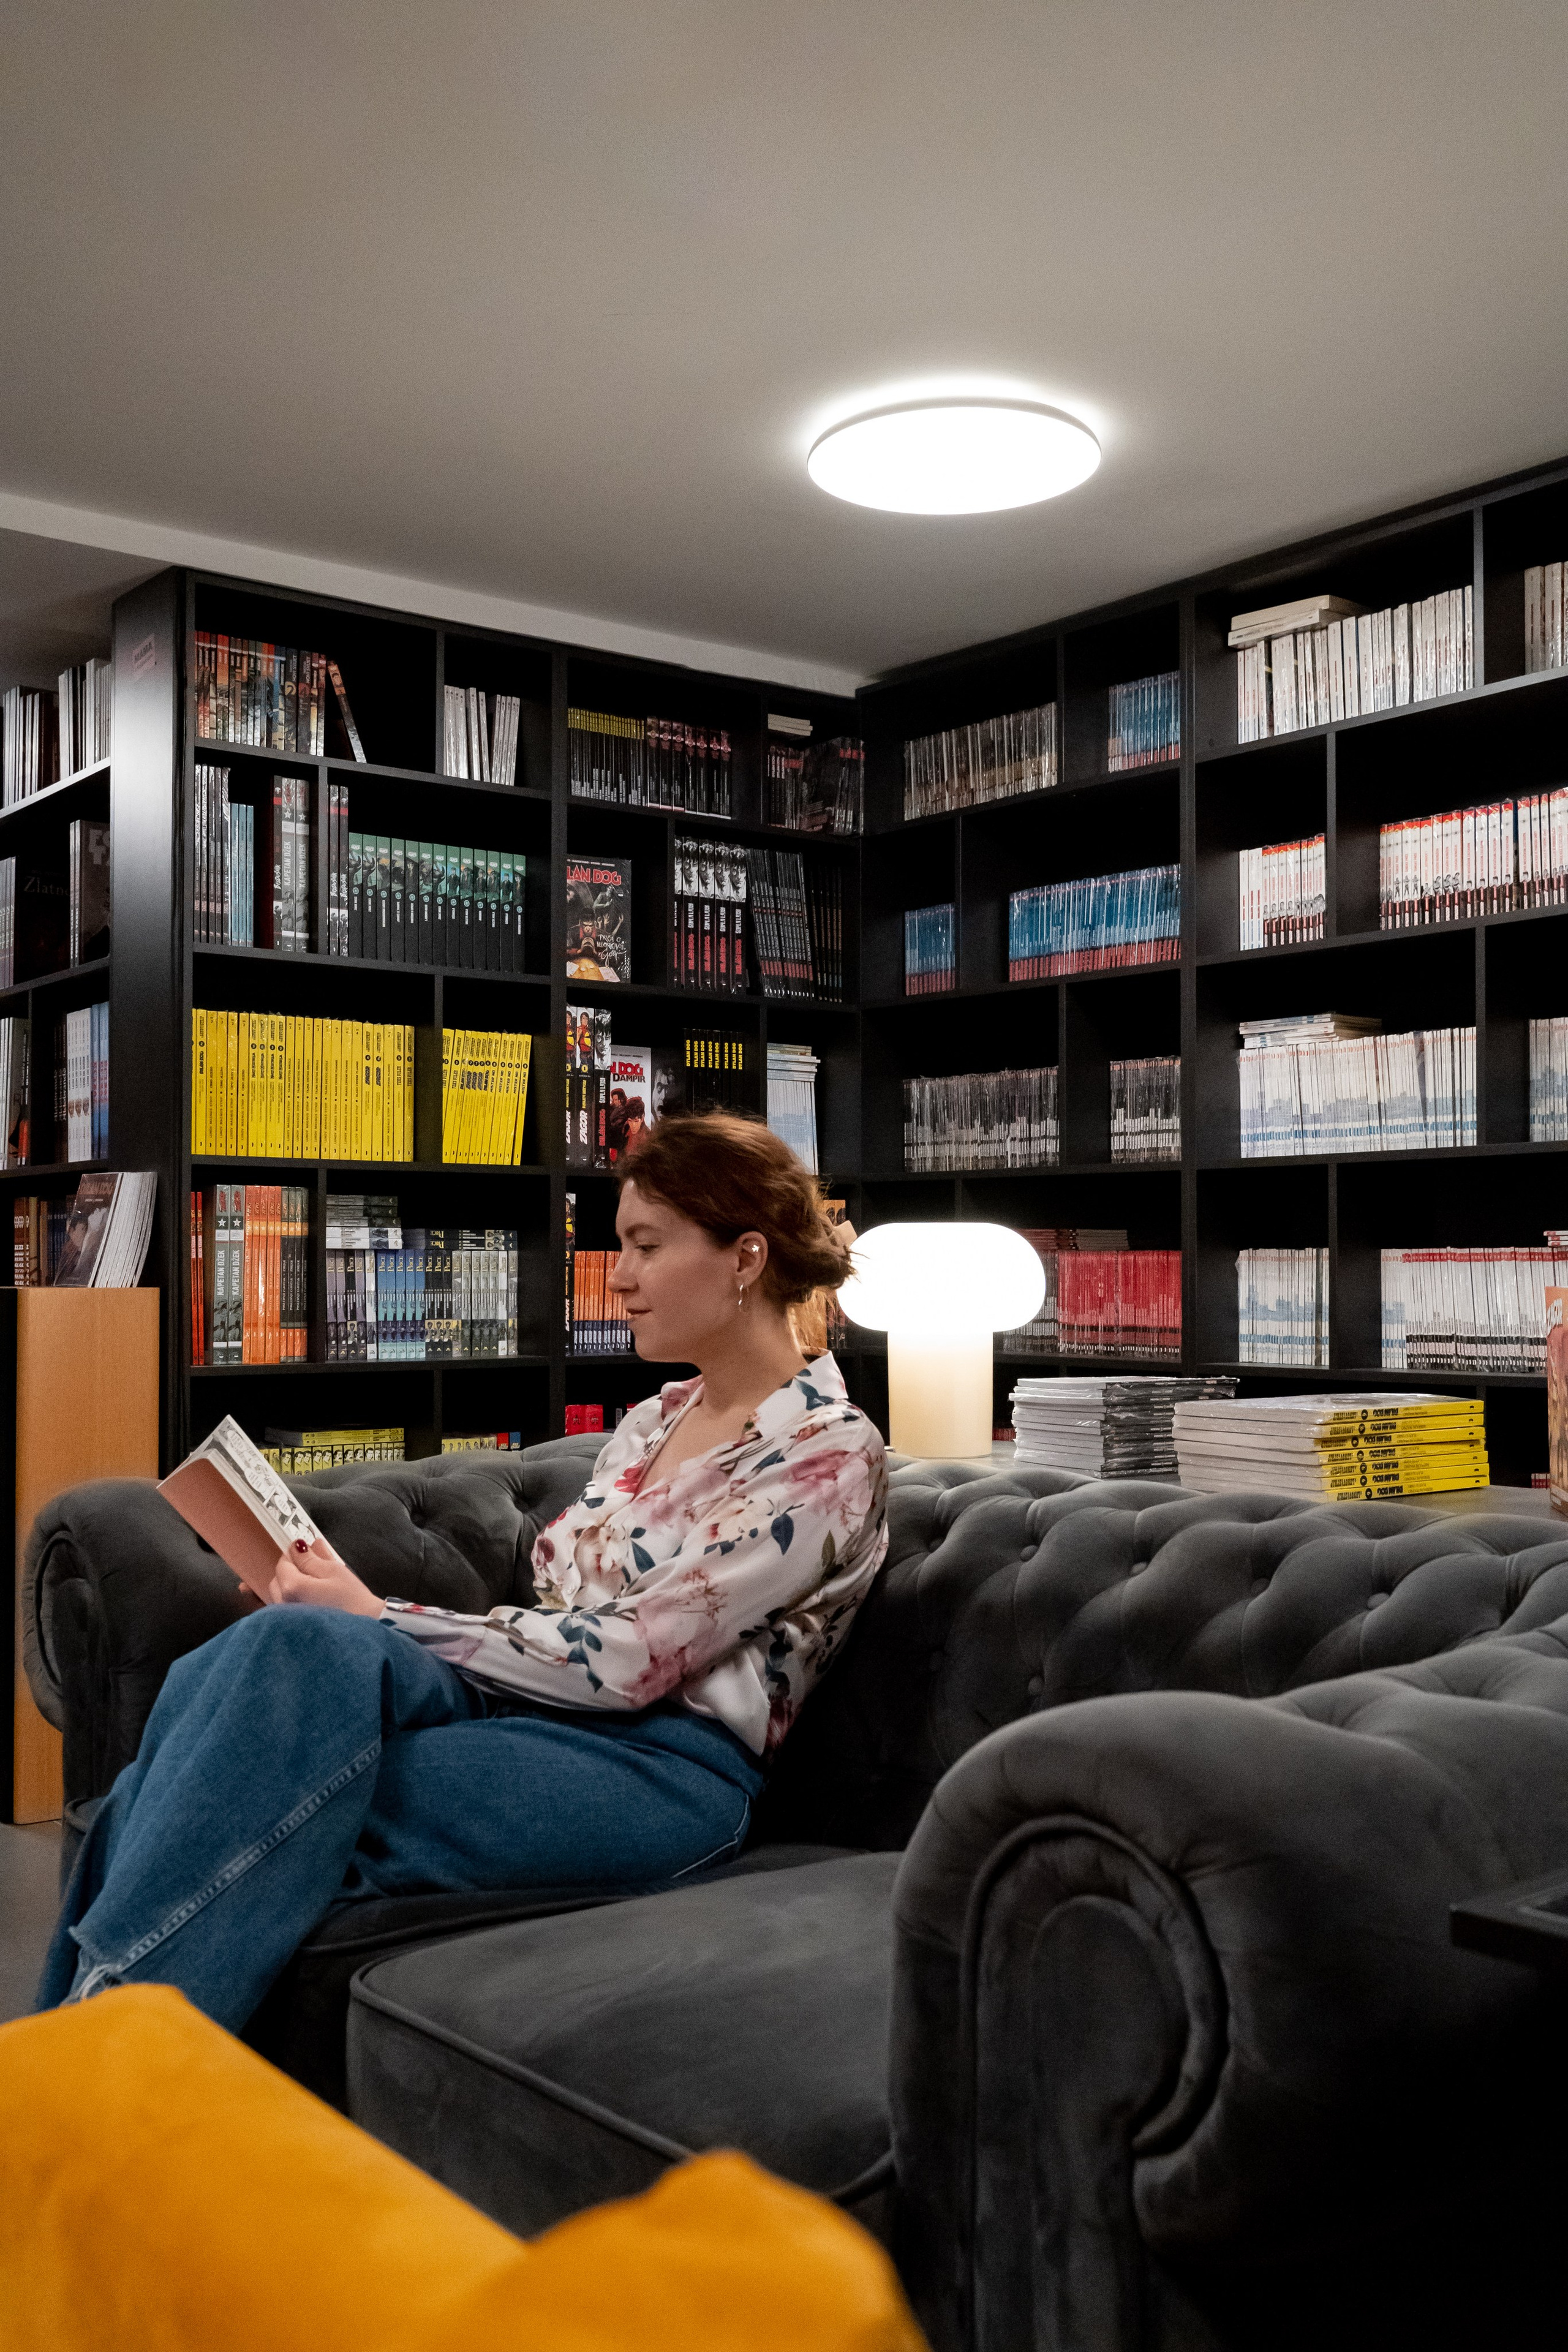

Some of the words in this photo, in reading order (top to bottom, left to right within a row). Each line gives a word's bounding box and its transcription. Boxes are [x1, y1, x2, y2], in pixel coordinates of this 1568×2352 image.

[567, 865, 591, 883] LAN
[594, 869, 621, 886] DOG
[619, 1062, 644, 1076] DOG
[613, 1074, 646, 1083] DAMPIR
[579, 1110, 588, 1144] ZAGOR
[216, 1250, 225, 1265] DŽEK
[231, 1250, 239, 1265] DŽEK
